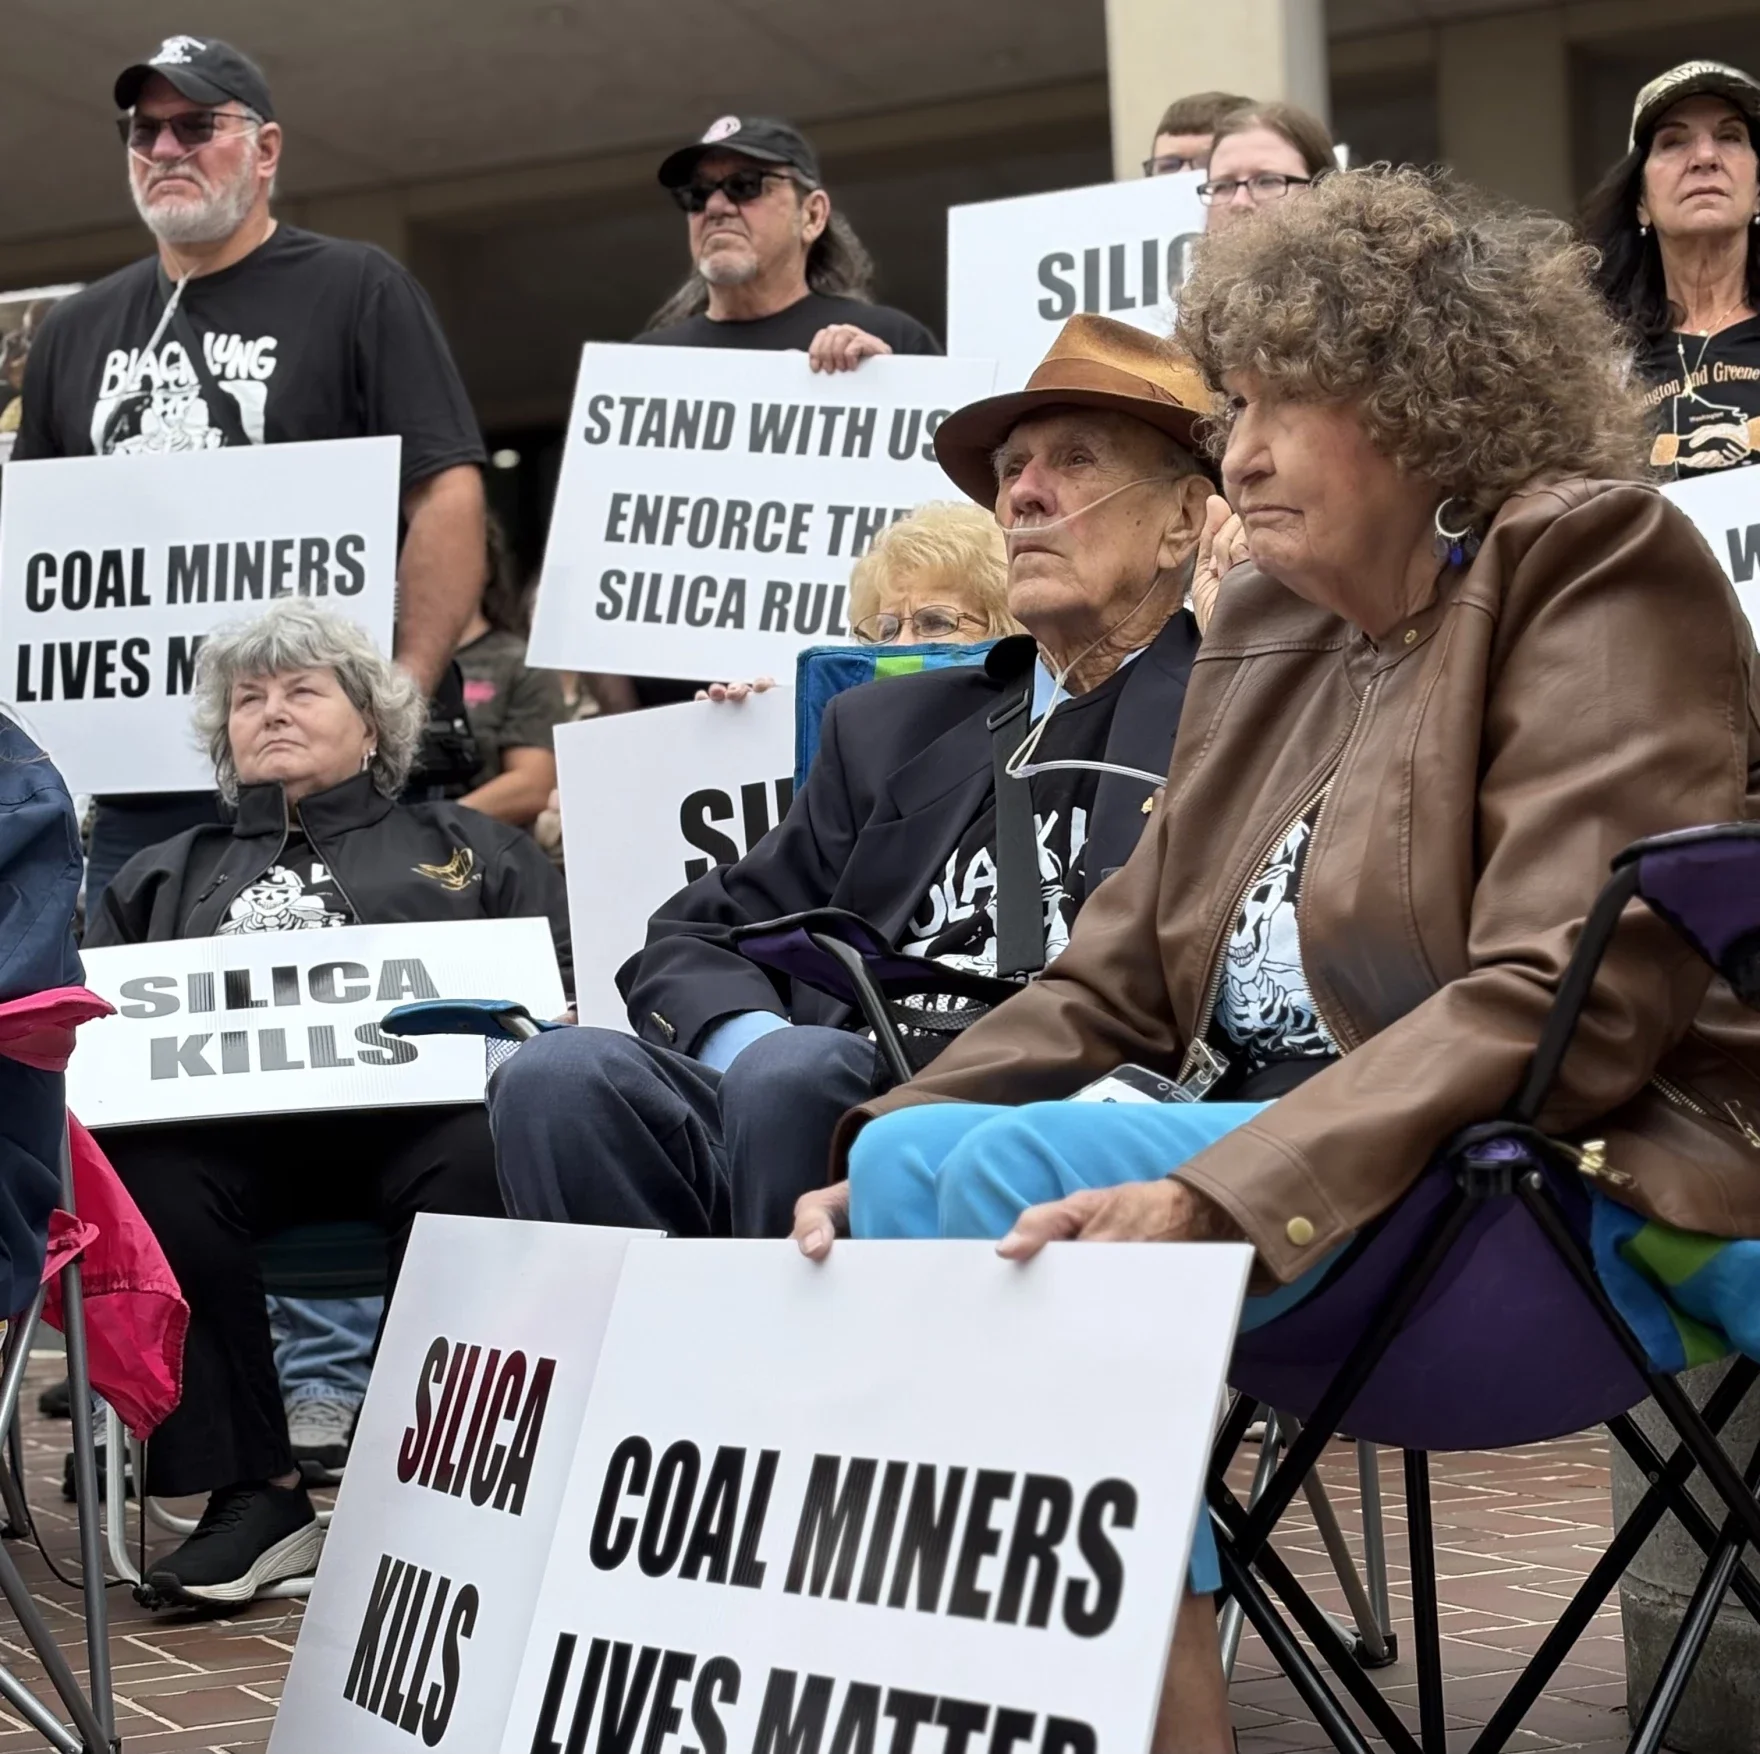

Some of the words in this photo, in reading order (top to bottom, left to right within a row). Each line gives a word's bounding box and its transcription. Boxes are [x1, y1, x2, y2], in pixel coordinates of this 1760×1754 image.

[203, 331, 278, 380] LUNG
[1713, 361, 1760, 383] Greene
[584, 394, 736, 451] STAND
[748, 403, 878, 458] WITH
[604, 492, 814, 555] ENFORCE
[827, 505, 910, 558] TH
[25, 547, 151, 613] COAL
[166, 534, 365, 605] MINERS
[595, 569, 746, 630] SILICA
[758, 581, 850, 637] RUL
[15, 637, 150, 703] LIVES
[119, 957, 441, 1020] SILICA
[150, 1022, 419, 1081] KILLS
[396, 1336, 557, 1517] SILICA
[589, 1435, 781, 1589] COAL
[783, 1453, 1139, 1639] MINERS
[342, 1552, 480, 1748] KILLS
[529, 1631, 742, 1754] LIVES
